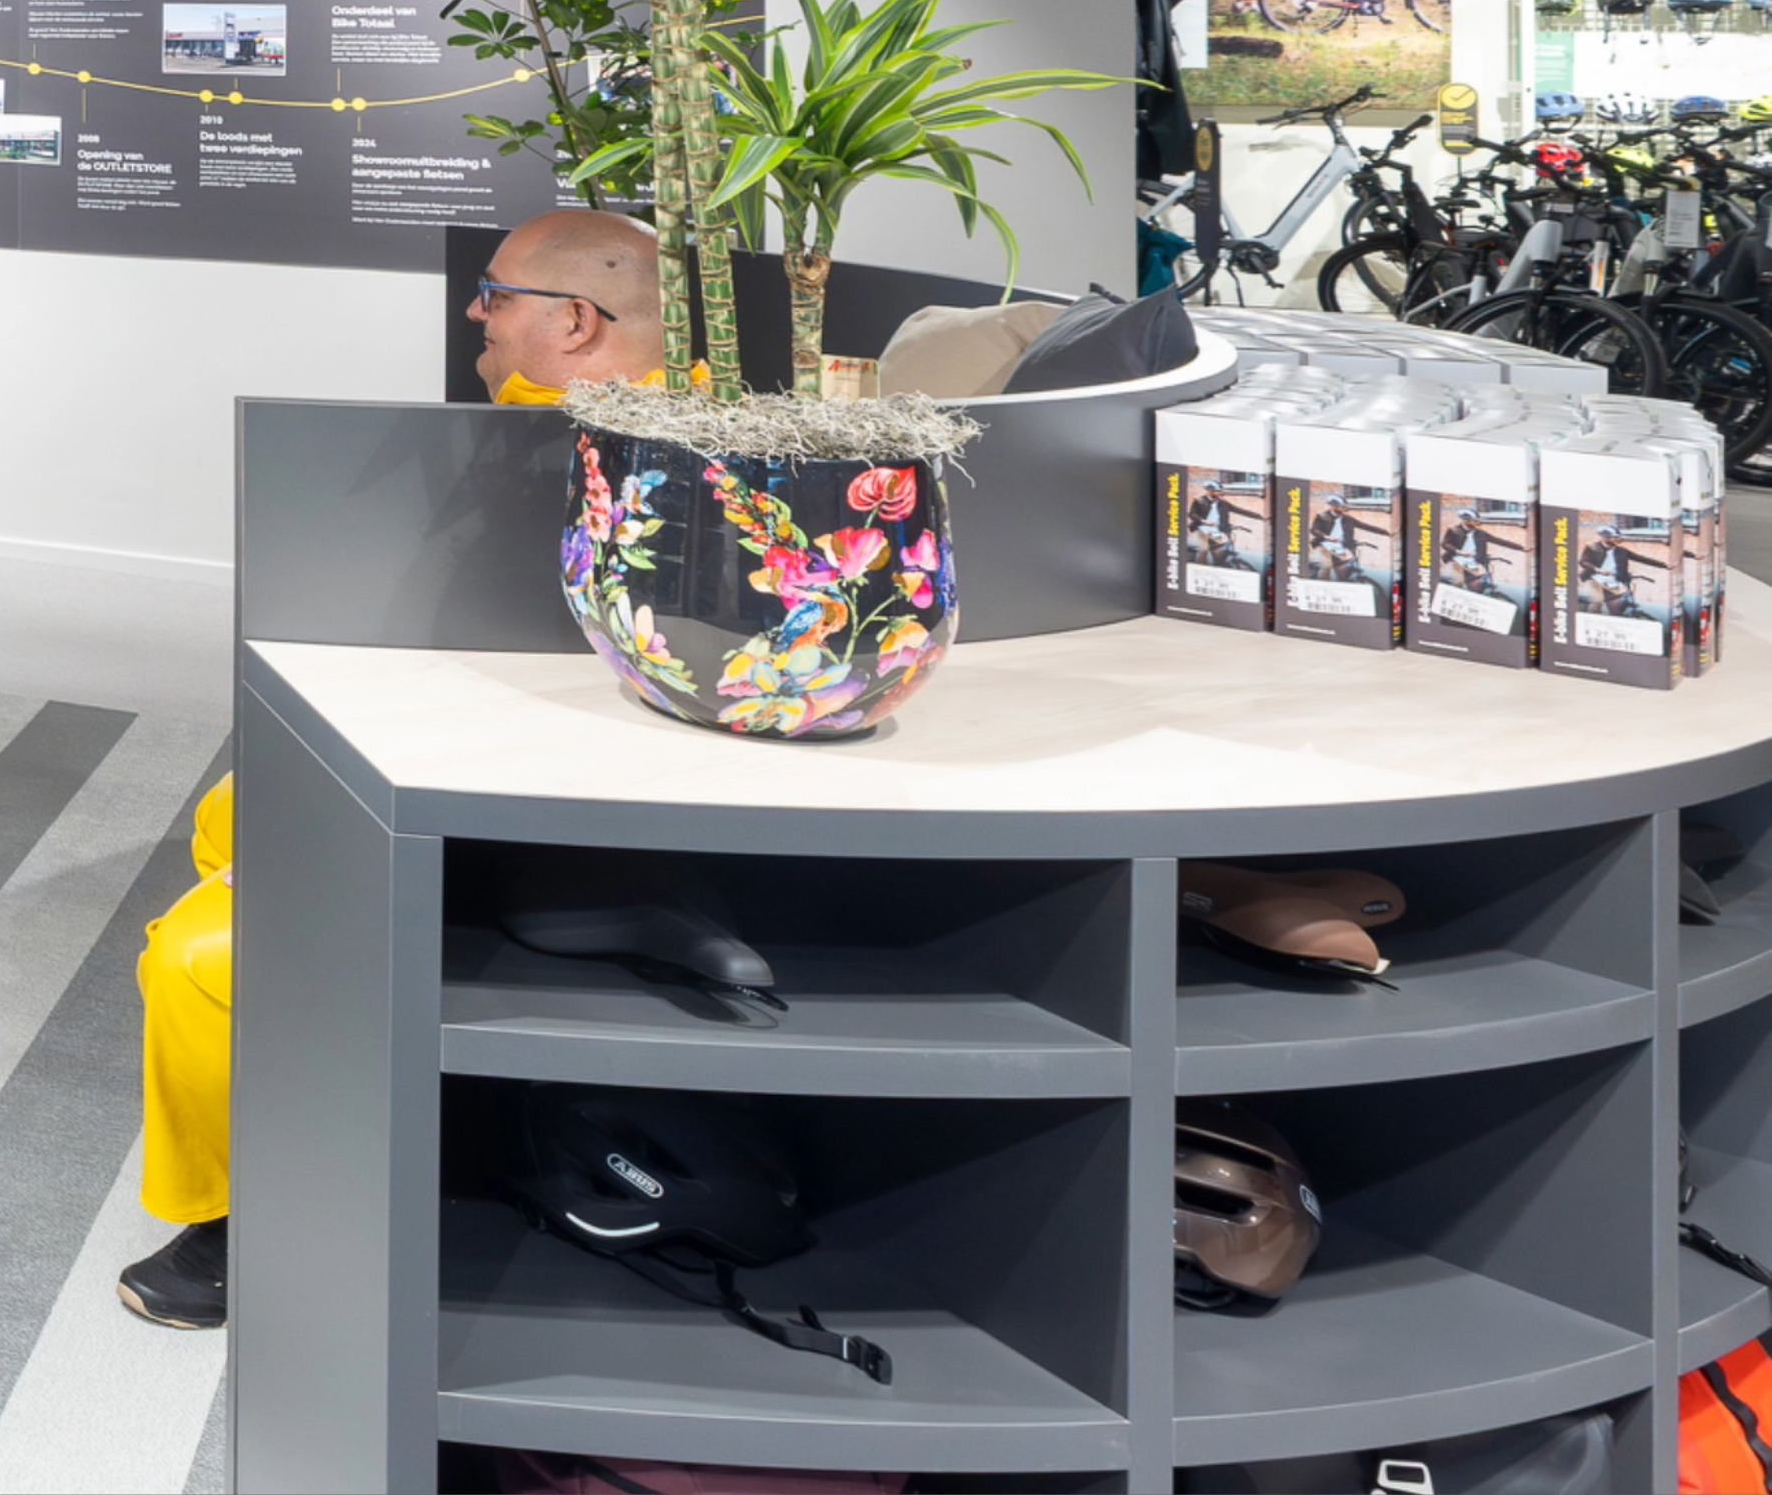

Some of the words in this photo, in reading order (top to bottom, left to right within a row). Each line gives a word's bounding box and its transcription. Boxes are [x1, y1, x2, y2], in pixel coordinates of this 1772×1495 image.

[331, 5, 394, 16] Onderdeel
[395, 7, 417, 16] van
[331, 17, 357, 28] Bike
[358, 17, 396, 28] Totaal
[199, 131, 215, 141] De
[217, 131, 248, 141] loods
[250, 133, 273, 142] met
[77, 149, 122, 161] Opening
[123, 152, 144, 161] van
[199, 143, 228, 153] twee
[229, 144, 303, 157] verdiepingen
[77, 162, 92, 171] de
[93, 162, 172, 174] OUTLETSTORE
[352, 153, 479, 170] Showroomuitbreiding
[481, 158, 491, 169] &
[352, 168, 421, 180] aangepaste
[423, 169, 465, 180] fietsen
[1167, 500, 1179, 538] Service
[1288, 513, 1301, 553] Service
[1419, 527, 1431, 568] Service
[1167, 558, 1179, 591] E-bike
[1555, 546, 1568, 586] Service
[1554, 612, 1567, 644] E-bike
[614, 1160, 658, 1194] ABUS
